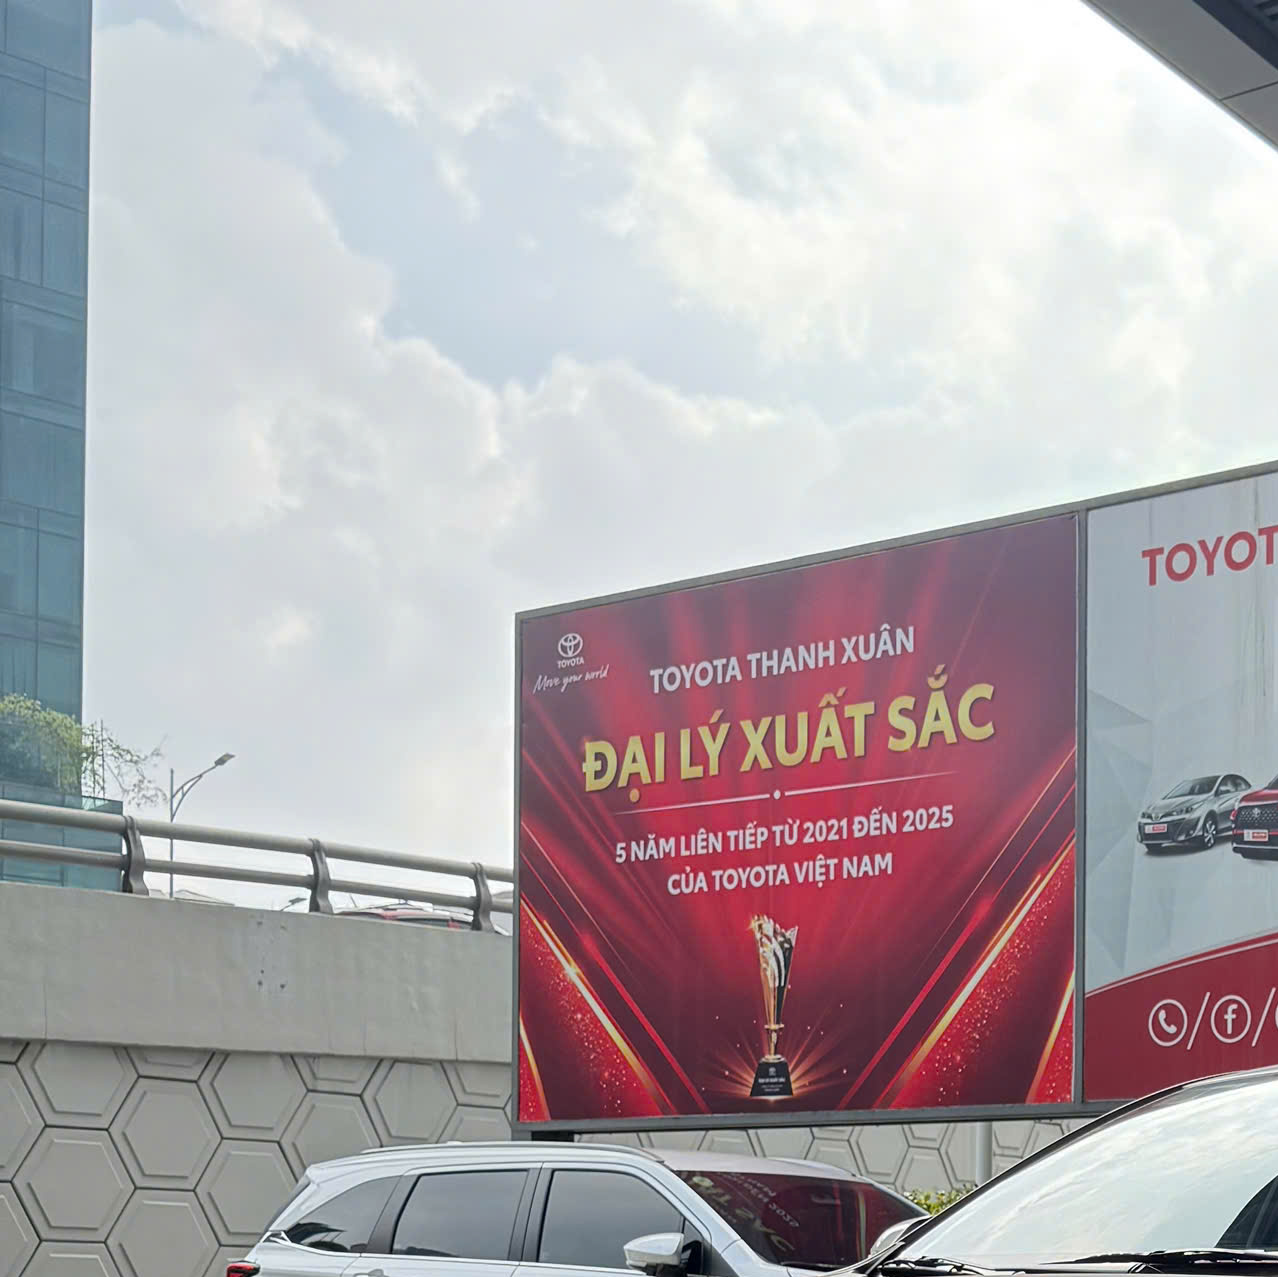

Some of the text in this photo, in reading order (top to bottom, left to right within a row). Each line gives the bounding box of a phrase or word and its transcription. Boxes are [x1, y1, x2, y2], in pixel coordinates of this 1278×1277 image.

[533, 663, 609, 694] Move your world
[557, 657, 585, 669] TOYOTA
[650, 623, 915, 694] TOYOTA THANH XUÂN
[582, 664, 996, 803] ĐẠI LÝ XUẤT SẮC
[615, 805, 954, 864] 5 NĂM LIÊN TIẾP TỪ 2021 ĐẾN 2025
[667, 852, 893, 896] CỦA TOYOTA VIỆT NAM
